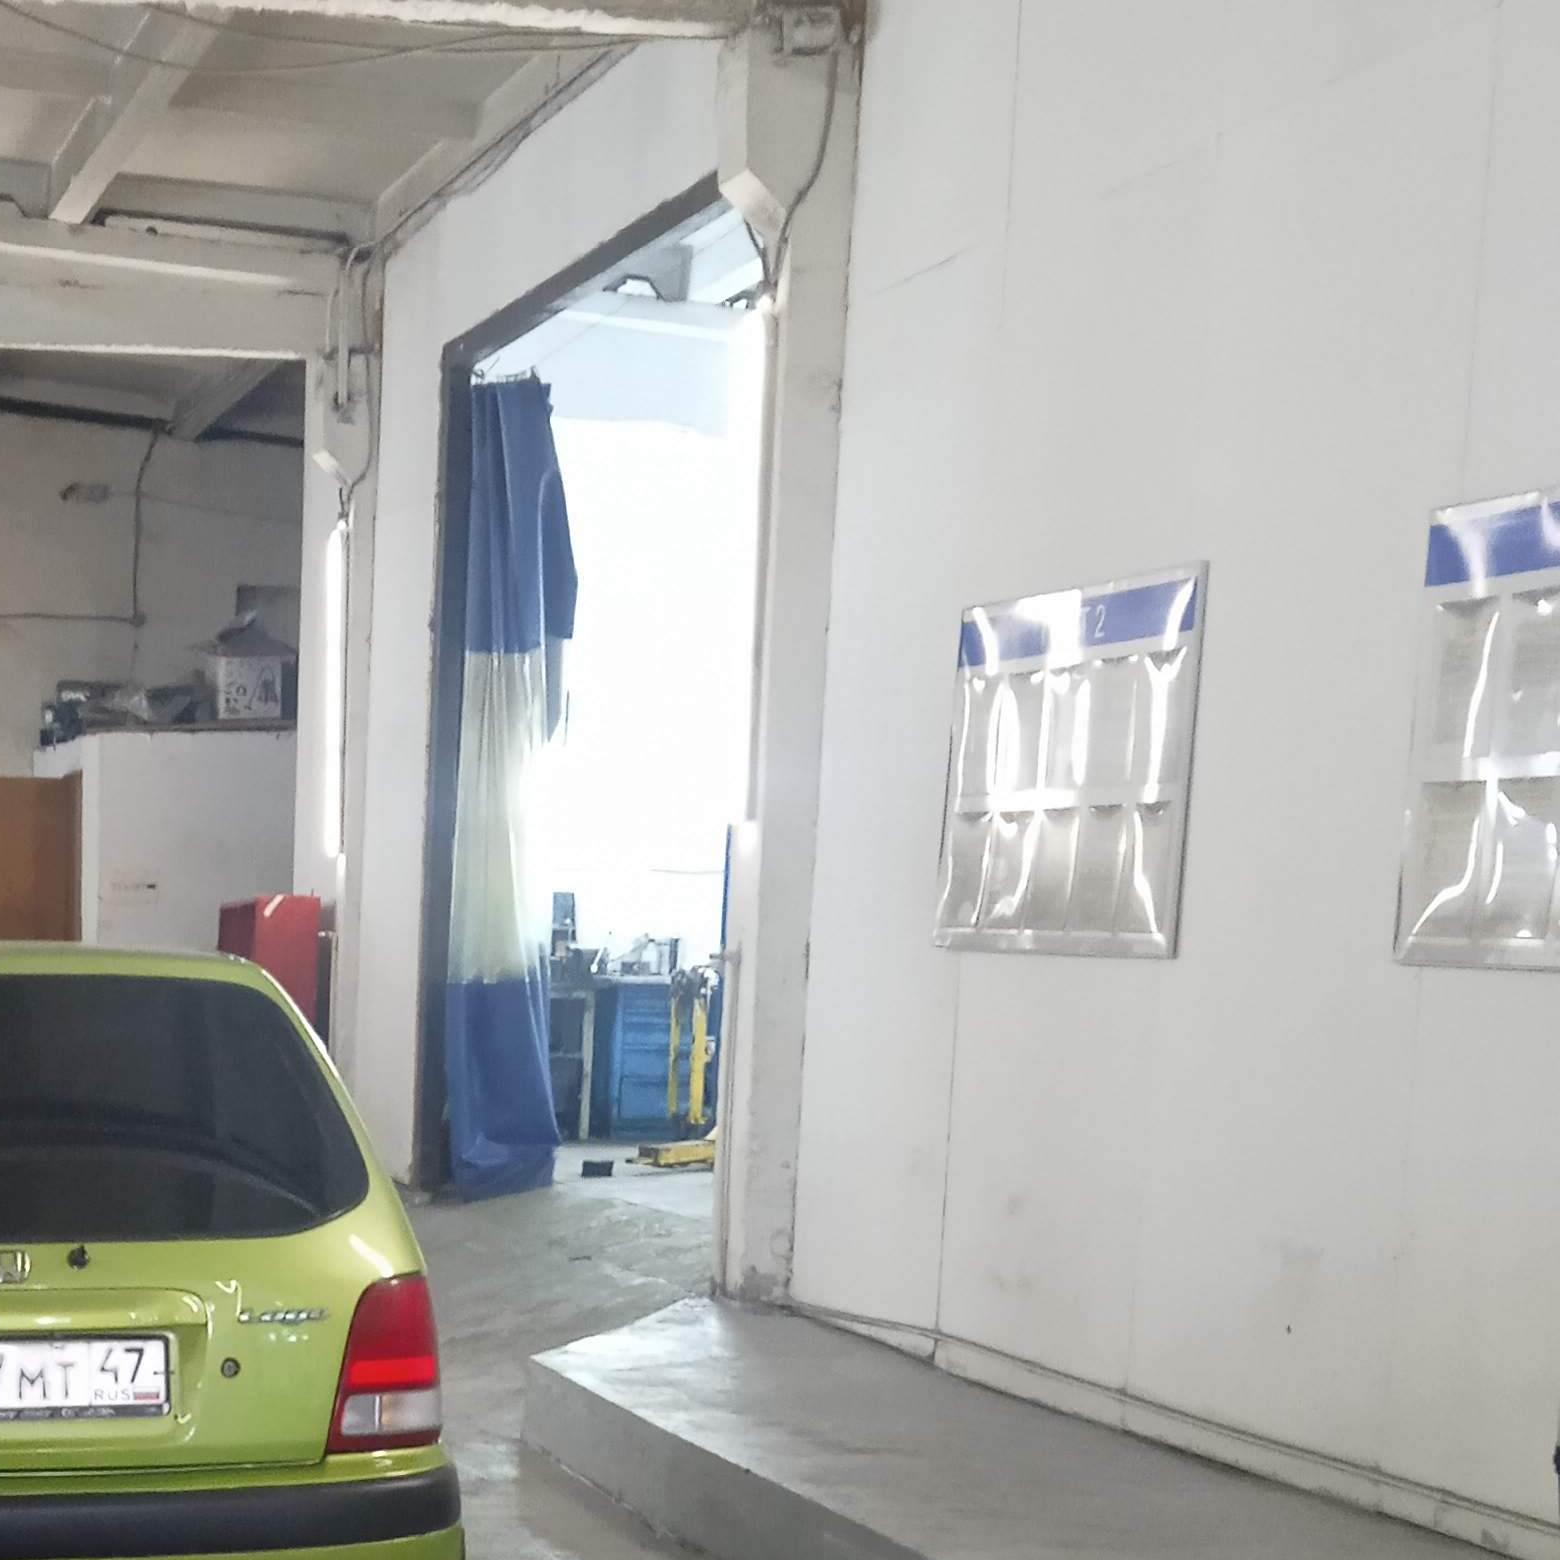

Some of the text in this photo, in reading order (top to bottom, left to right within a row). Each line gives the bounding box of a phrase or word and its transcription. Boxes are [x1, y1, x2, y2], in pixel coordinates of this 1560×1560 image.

[1094, 603, 1106, 639] 2
[100, 1347, 144, 1384] 47
[93, 1389, 131, 1401] RUS
